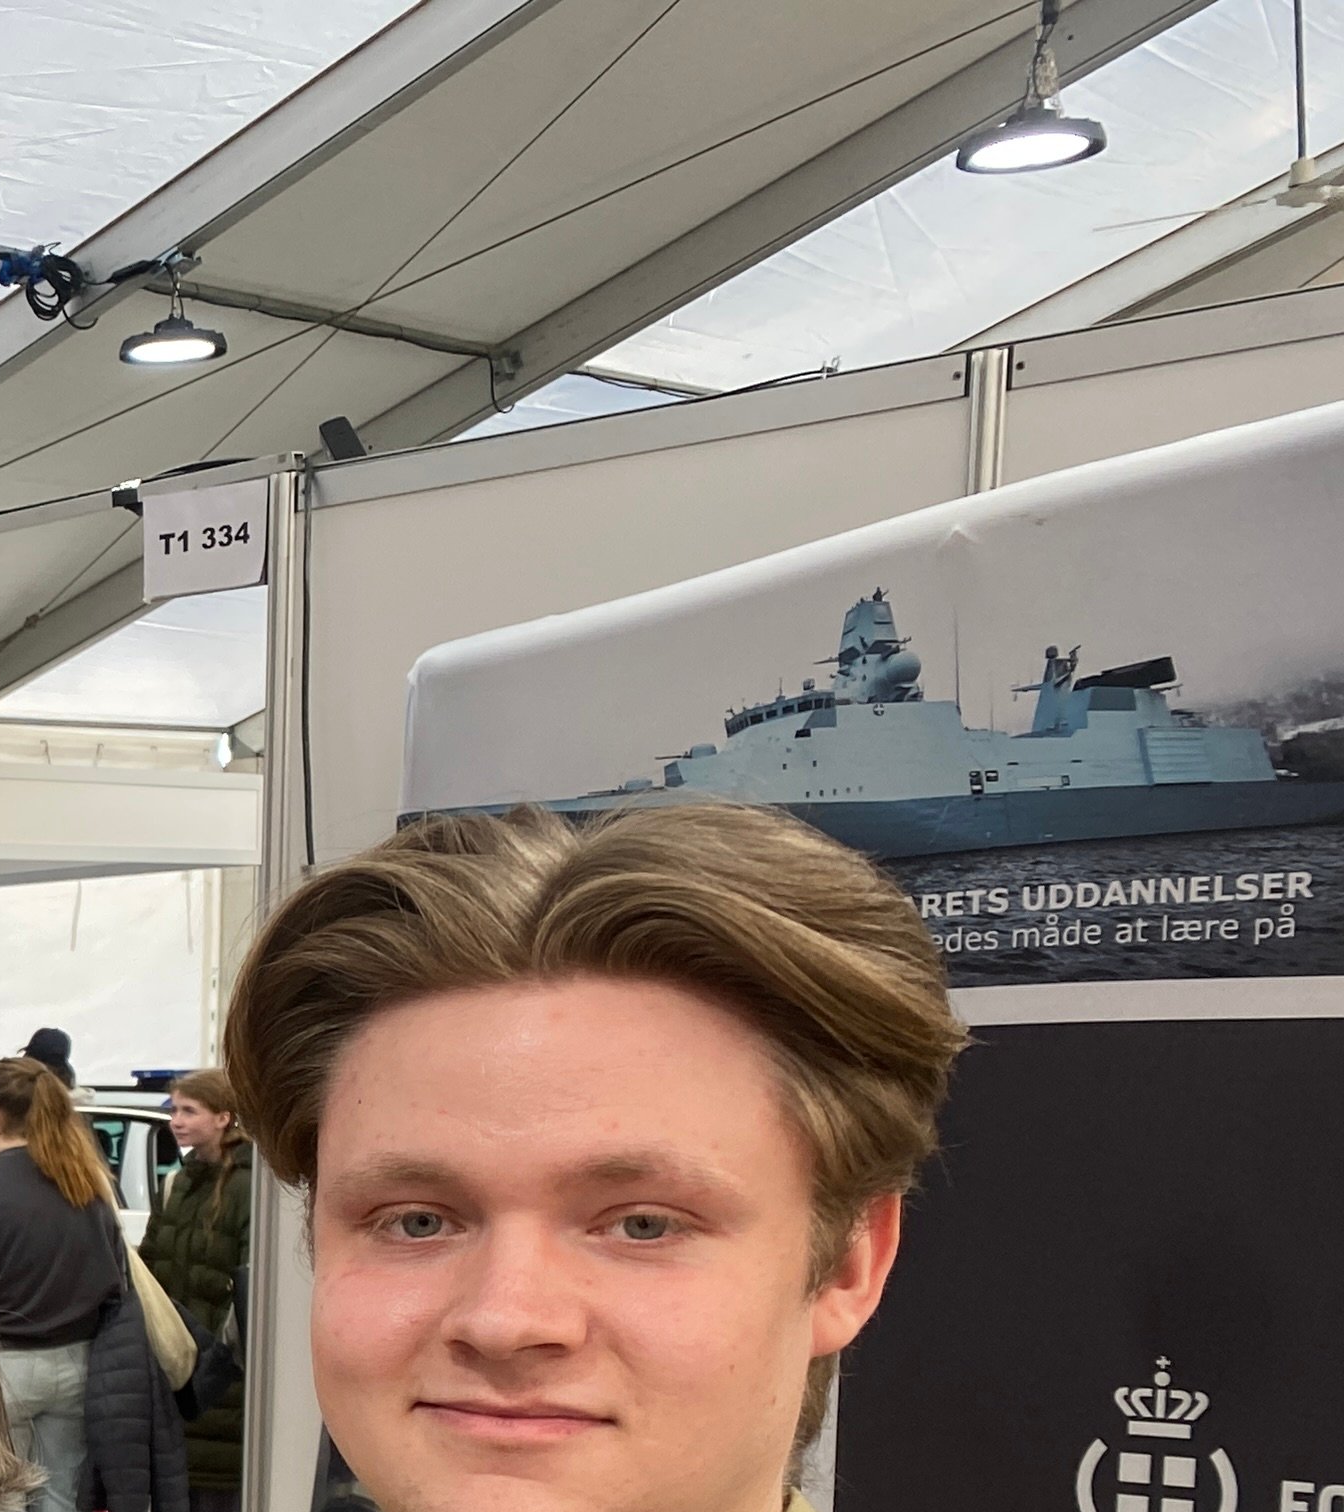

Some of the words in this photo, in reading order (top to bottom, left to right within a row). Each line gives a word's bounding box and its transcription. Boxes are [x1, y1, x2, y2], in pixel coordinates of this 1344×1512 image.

[159, 530, 189, 554] T1
[201, 522, 250, 549] 334
[906, 887, 1009, 918] RETS
[1022, 871, 1313, 912] UDDANNELSER
[1012, 914, 1103, 949] måde
[1114, 917, 1149, 944] at
[1161, 914, 1240, 942] lære
[1254, 903, 1296, 945] på
